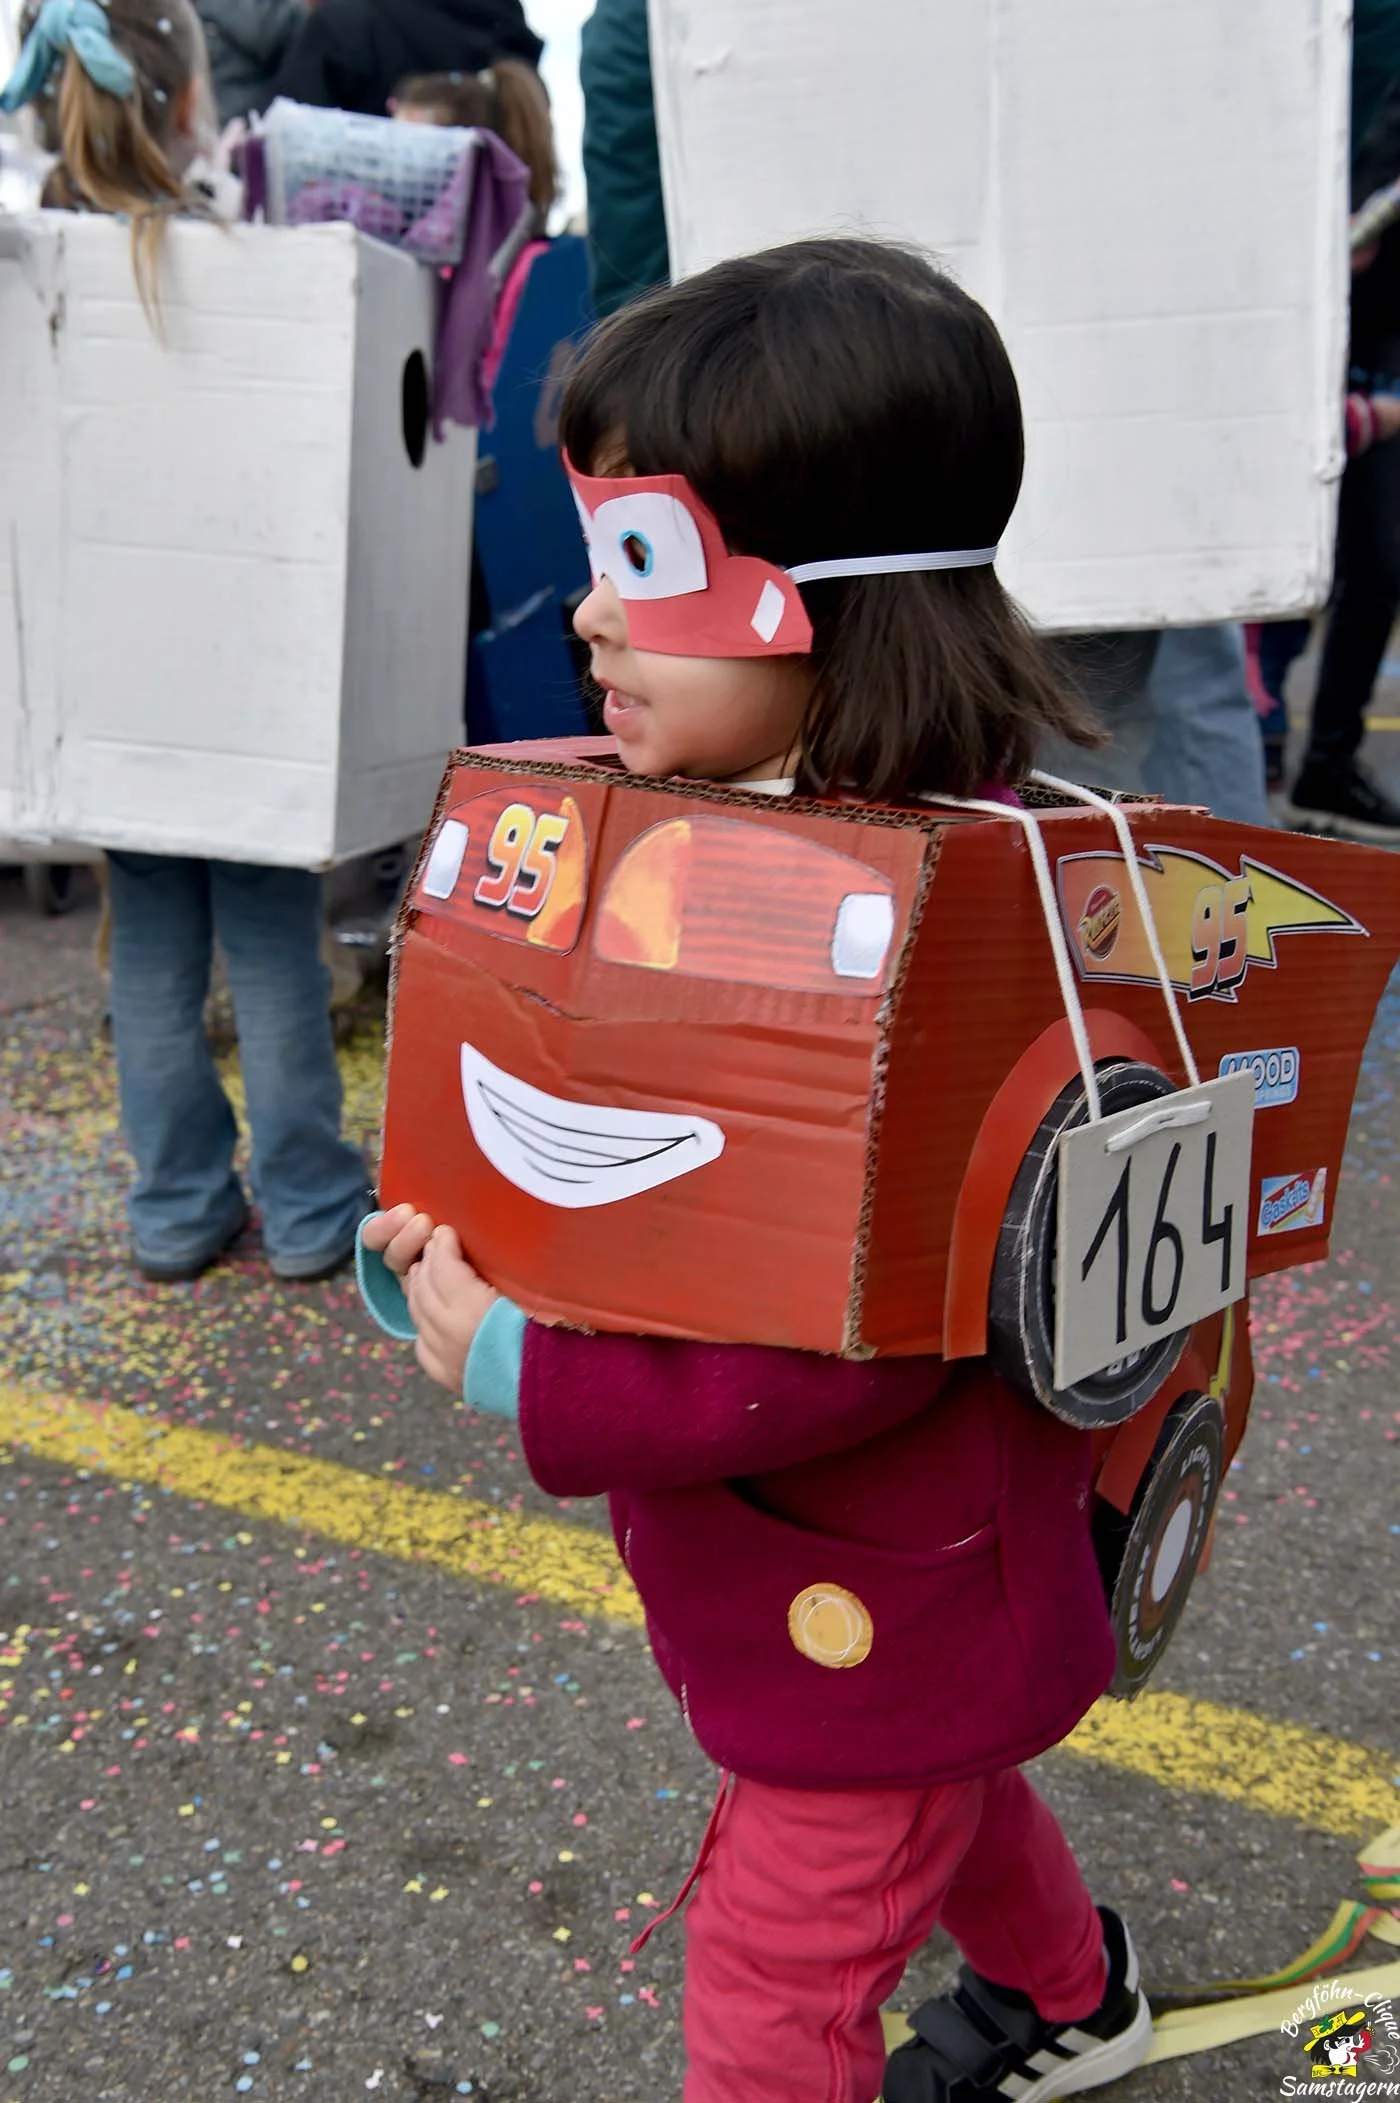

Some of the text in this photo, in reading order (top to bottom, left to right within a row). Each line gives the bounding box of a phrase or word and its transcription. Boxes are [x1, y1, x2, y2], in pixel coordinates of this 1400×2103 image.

[474, 803, 569, 918] 95
[1188, 877, 1252, 1001] 95
[1082, 1131, 1233, 1345] 164
